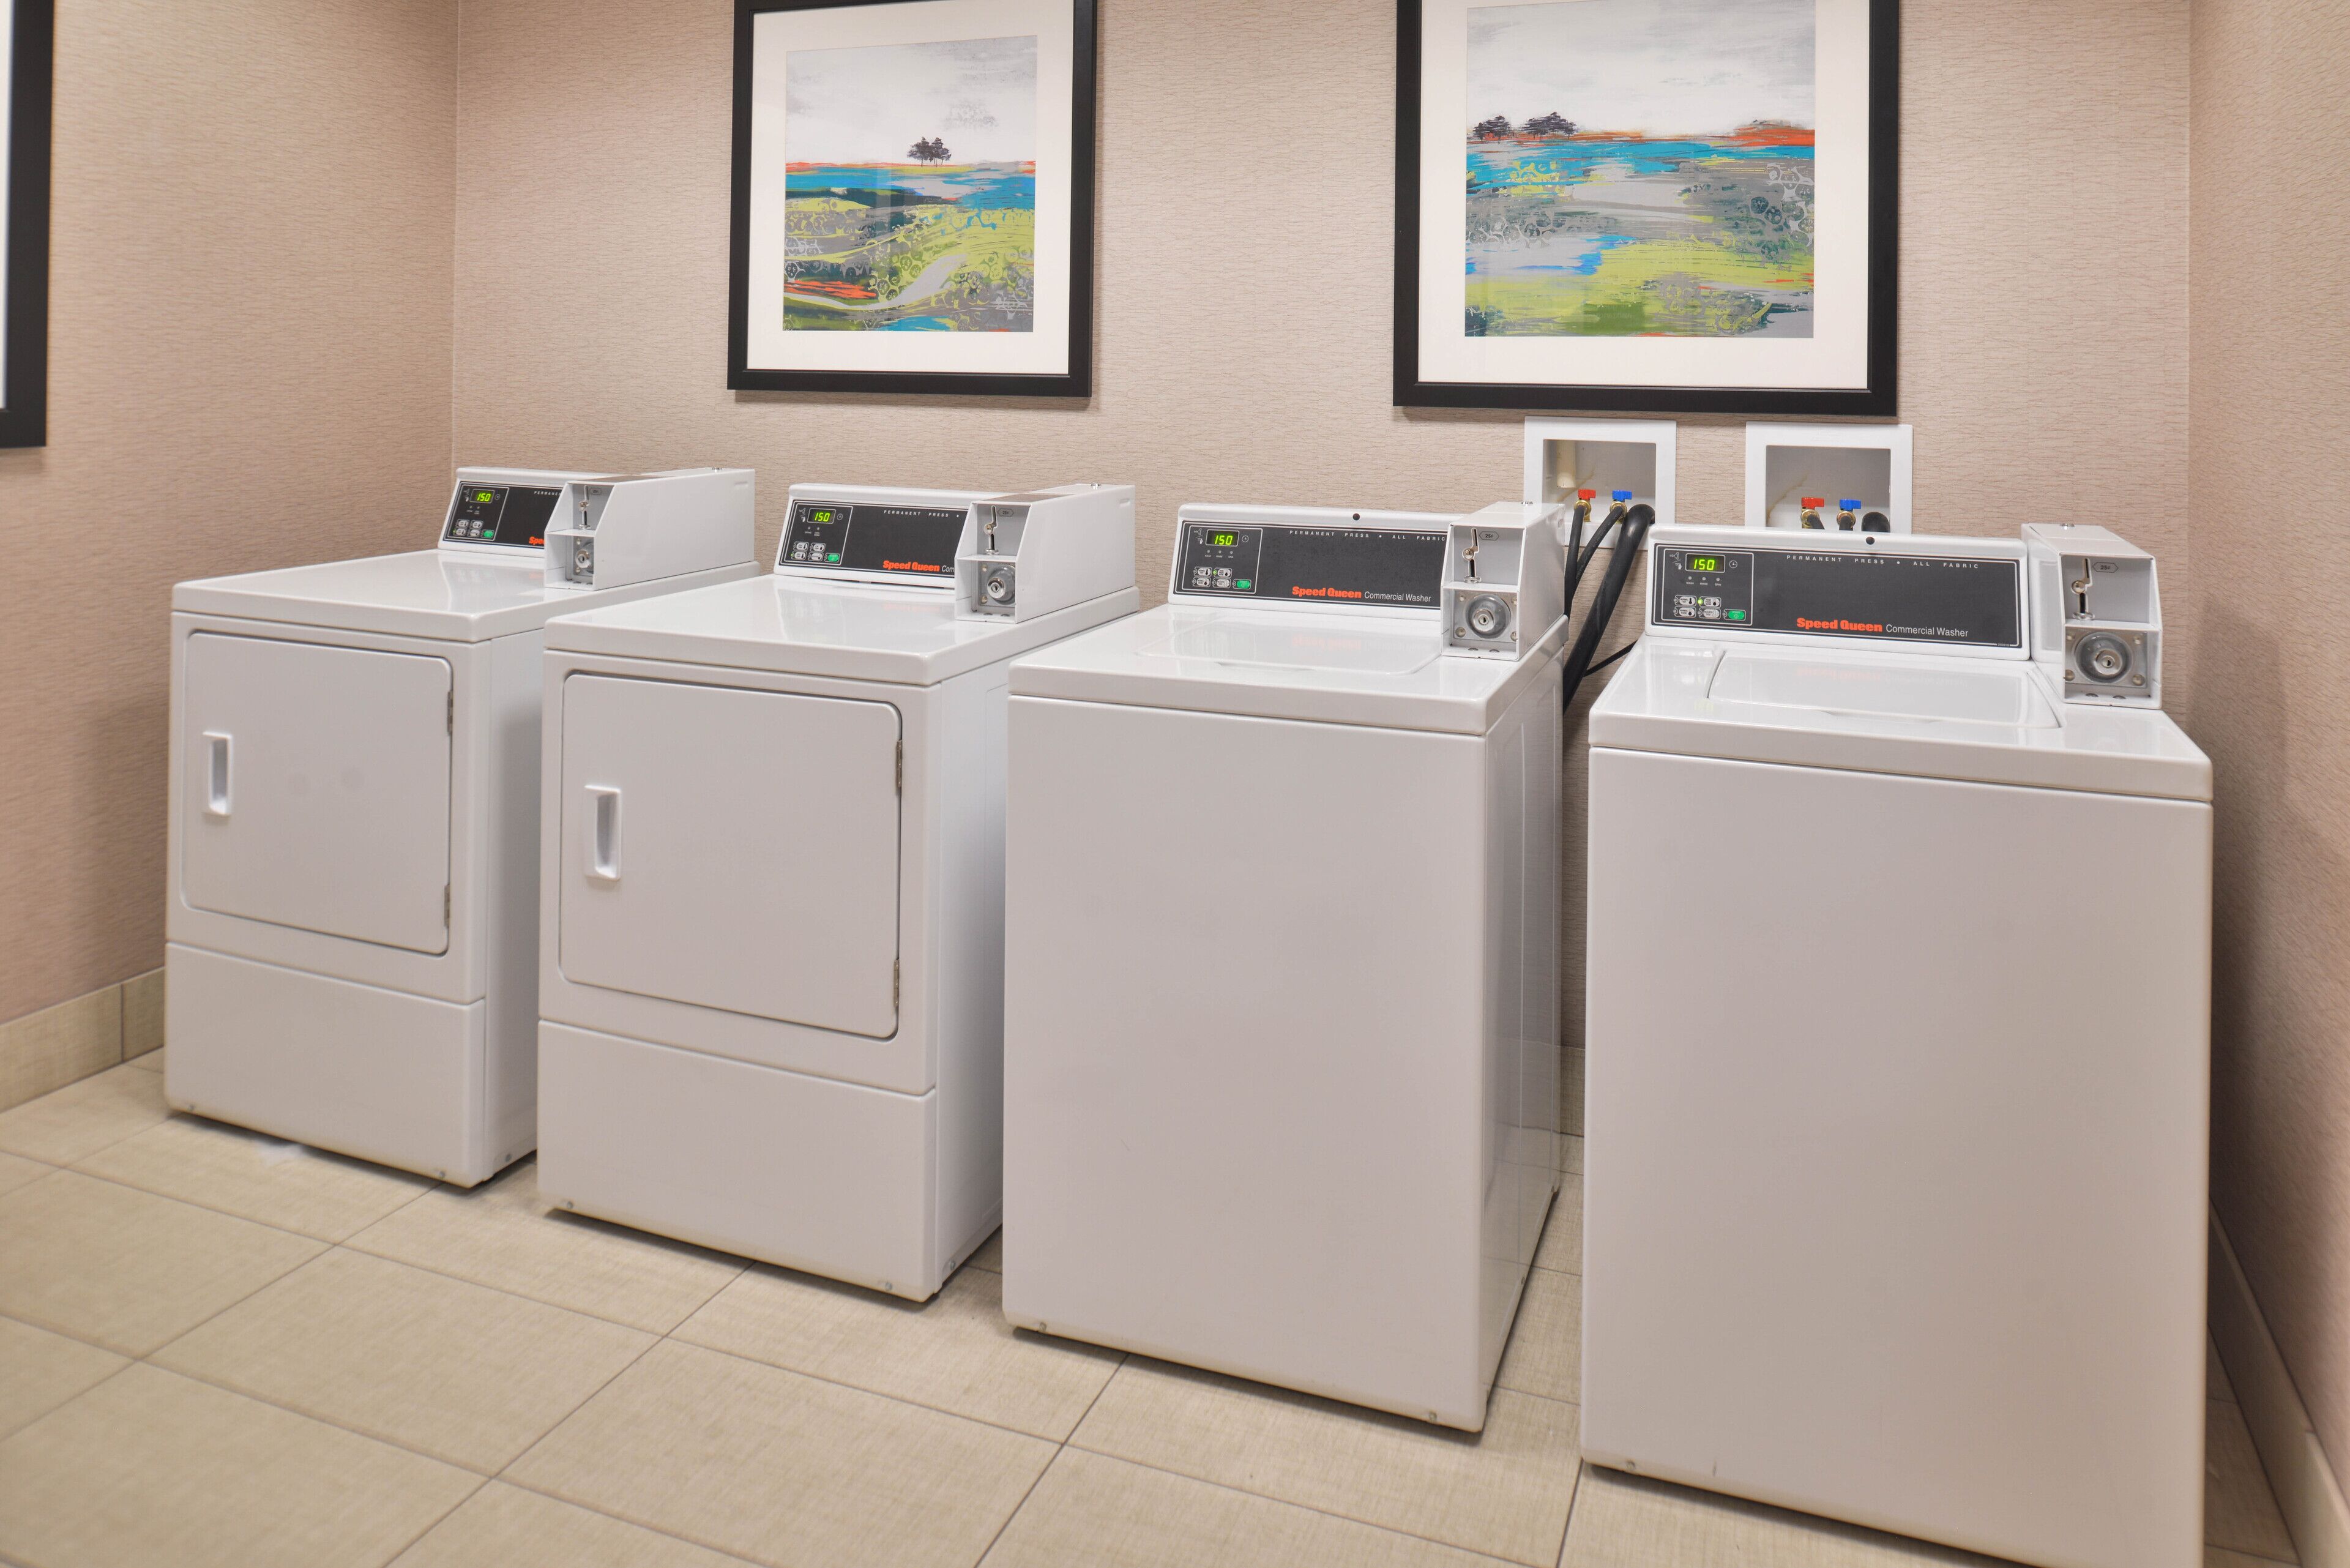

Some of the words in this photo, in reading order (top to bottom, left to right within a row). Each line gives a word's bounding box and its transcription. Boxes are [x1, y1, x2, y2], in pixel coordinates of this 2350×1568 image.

[477, 493, 491, 502] 150
[814, 512, 830, 522] 150
[1214, 535, 1233, 545] 150
[882, 560, 911, 570] Speed
[911, 562, 941, 572] Queen
[1693, 559, 1715, 570] 150
[1292, 586, 1326, 597] Speed
[1327, 588, 1362, 599] Queen
[1364, 591, 1404, 601] Commercial
[1405, 593, 1431, 602] Washer
[1796, 618, 1838, 630] Speed
[1840, 619, 1882, 632] Queen
[1886, 624, 1934, 635] Commercial
[1936, 627, 1969, 637] Washer
